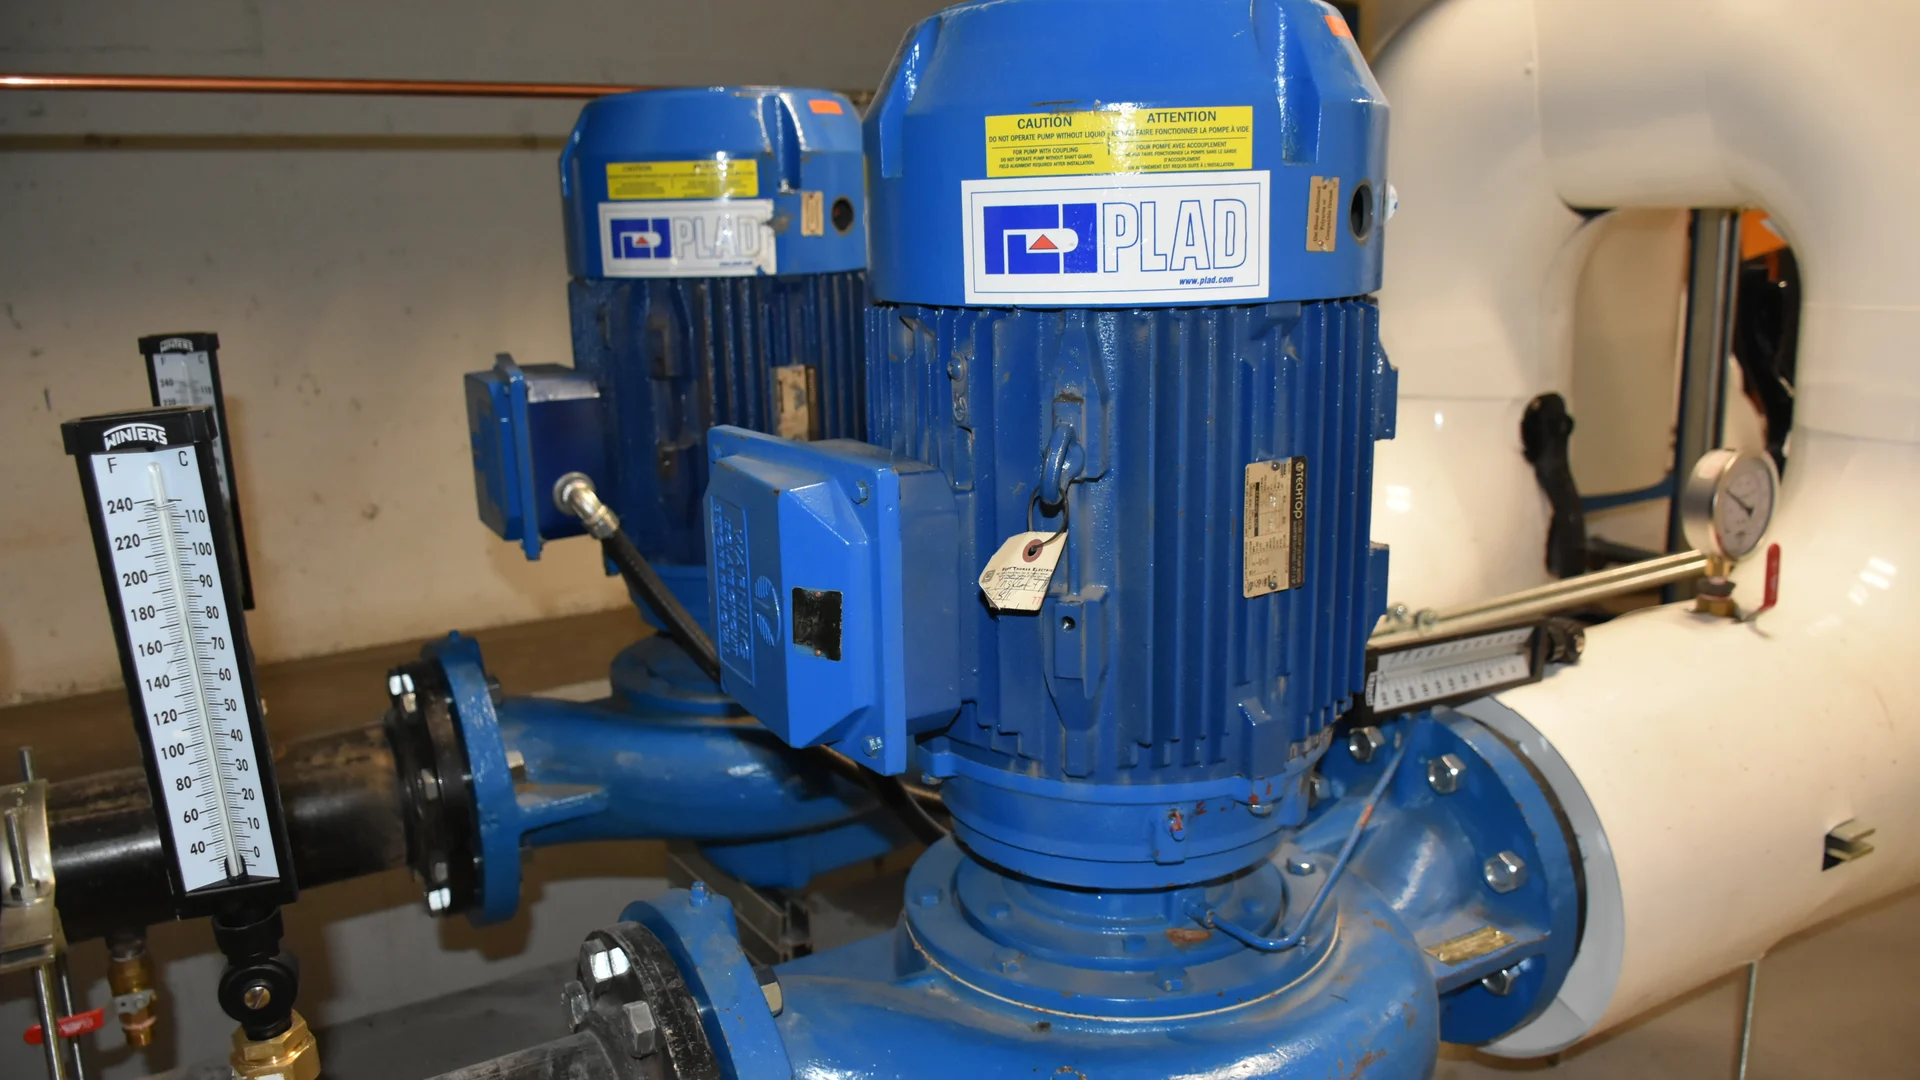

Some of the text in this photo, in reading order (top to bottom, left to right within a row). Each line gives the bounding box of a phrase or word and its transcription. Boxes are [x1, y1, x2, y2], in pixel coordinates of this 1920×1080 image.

[1018, 116, 1072, 129] CAUTION
[1147, 110, 1216, 124] ATTENTION
[1155, 126, 1198, 135] FONCTIONNER
[672, 216, 761, 259] PLAD
[1103, 198, 1247, 272] PLAD
[1179, 275, 1233, 286] www.plad.com
[103, 423, 168, 451] WINTERS
[107, 451, 188, 473] F C
[1293, 473, 1304, 519] TECHTOP
[107, 497, 133, 514] 240
[186, 509, 206, 523] 110
[115, 534, 140, 551] 220
[192, 542, 212, 556] 100
[123, 570, 148, 587] 200
[200, 574, 213, 588] 90
[131, 605, 156, 622] 180
[206, 606, 219, 619] 80
[139, 640, 163, 657] 160
[212, 637, 225, 650] 70
[219, 668, 231, 681] 60
[146, 674, 170, 691] 140
[224, 699, 237, 712] 50
[154, 709, 178, 726] 120
[230, 729, 243, 742] 40
[161, 742, 185, 760] 100
[235, 759, 249, 771] 30
[176, 776, 192, 791] 80
[242, 788, 255, 800] 20
[184, 808, 199, 823] 60
[247, 817, 260, 830] 10
[190, 841, 206, 855] 40
[254, 846, 260, 858] 0
